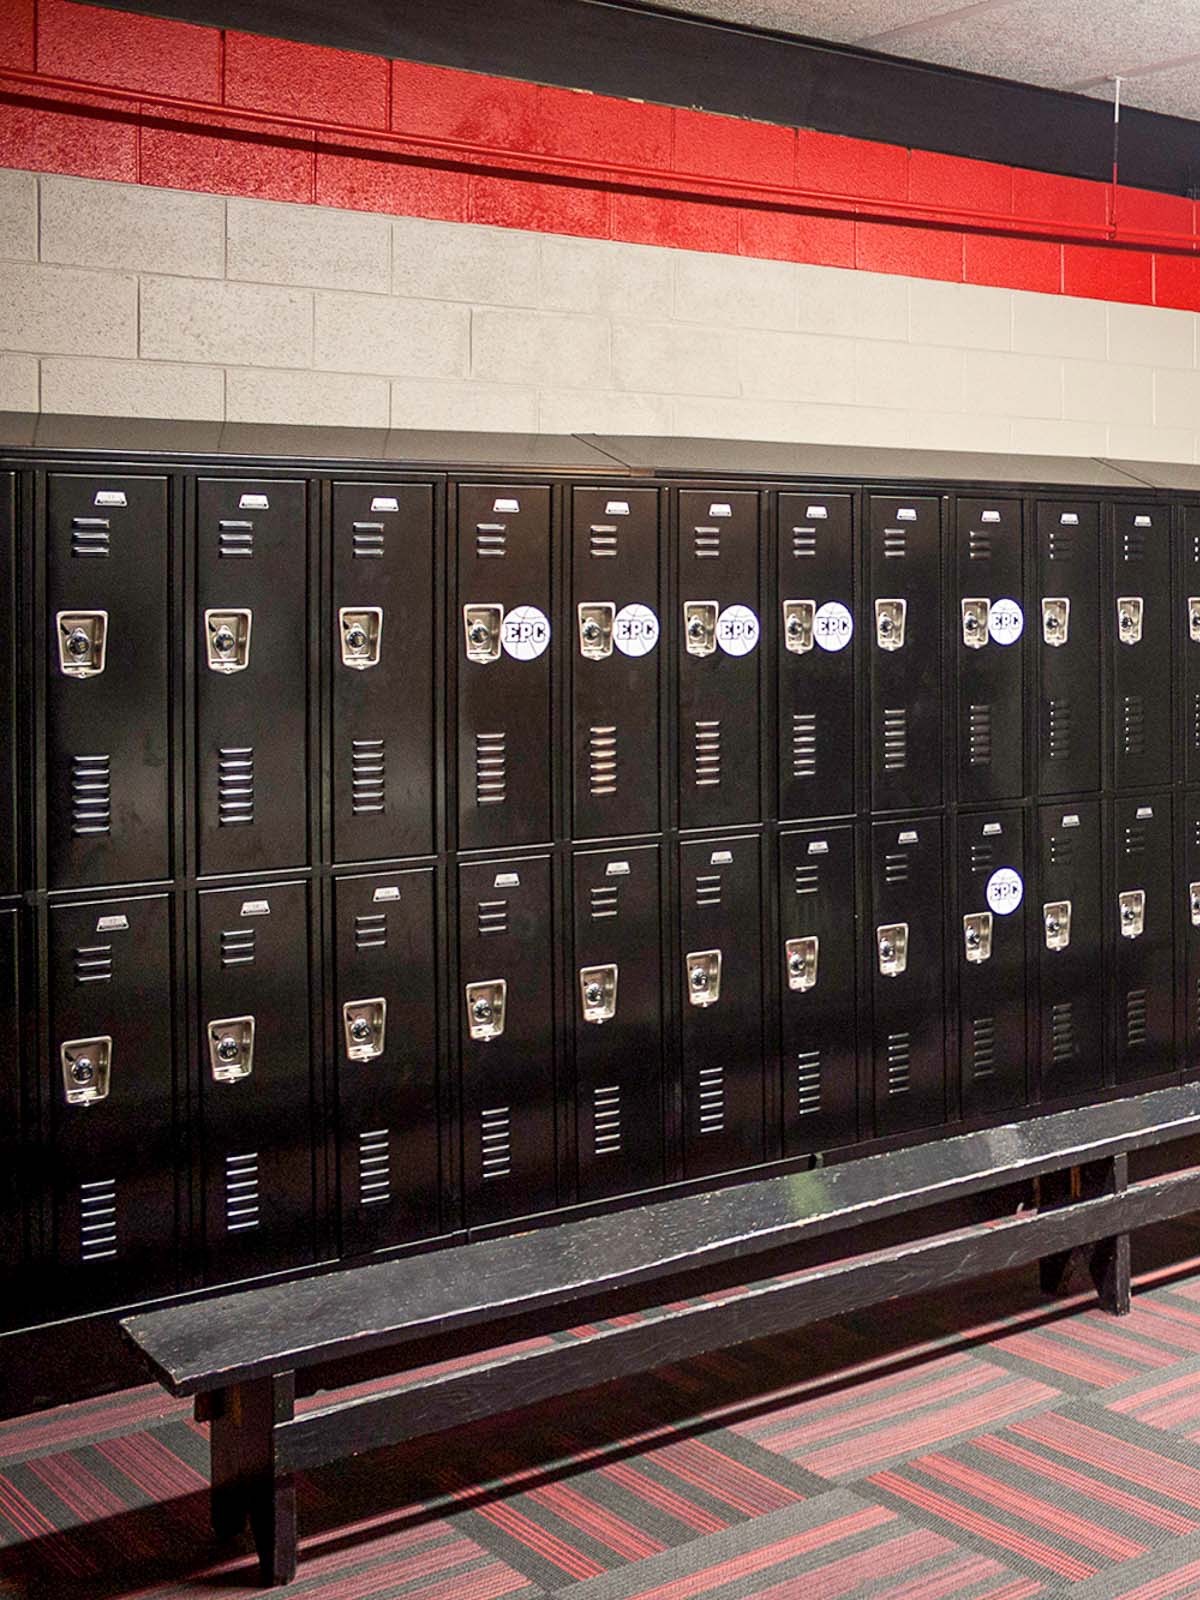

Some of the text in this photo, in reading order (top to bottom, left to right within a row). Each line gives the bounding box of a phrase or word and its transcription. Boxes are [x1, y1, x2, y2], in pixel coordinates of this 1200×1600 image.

[616, 619, 655, 641] EPC
[719, 618, 756, 640] EPC
[816, 615, 850, 636] EPC
[990, 611, 1020, 630] EPC
[505, 621, 546, 643] EPC
[989, 880, 1019, 901] EPC
